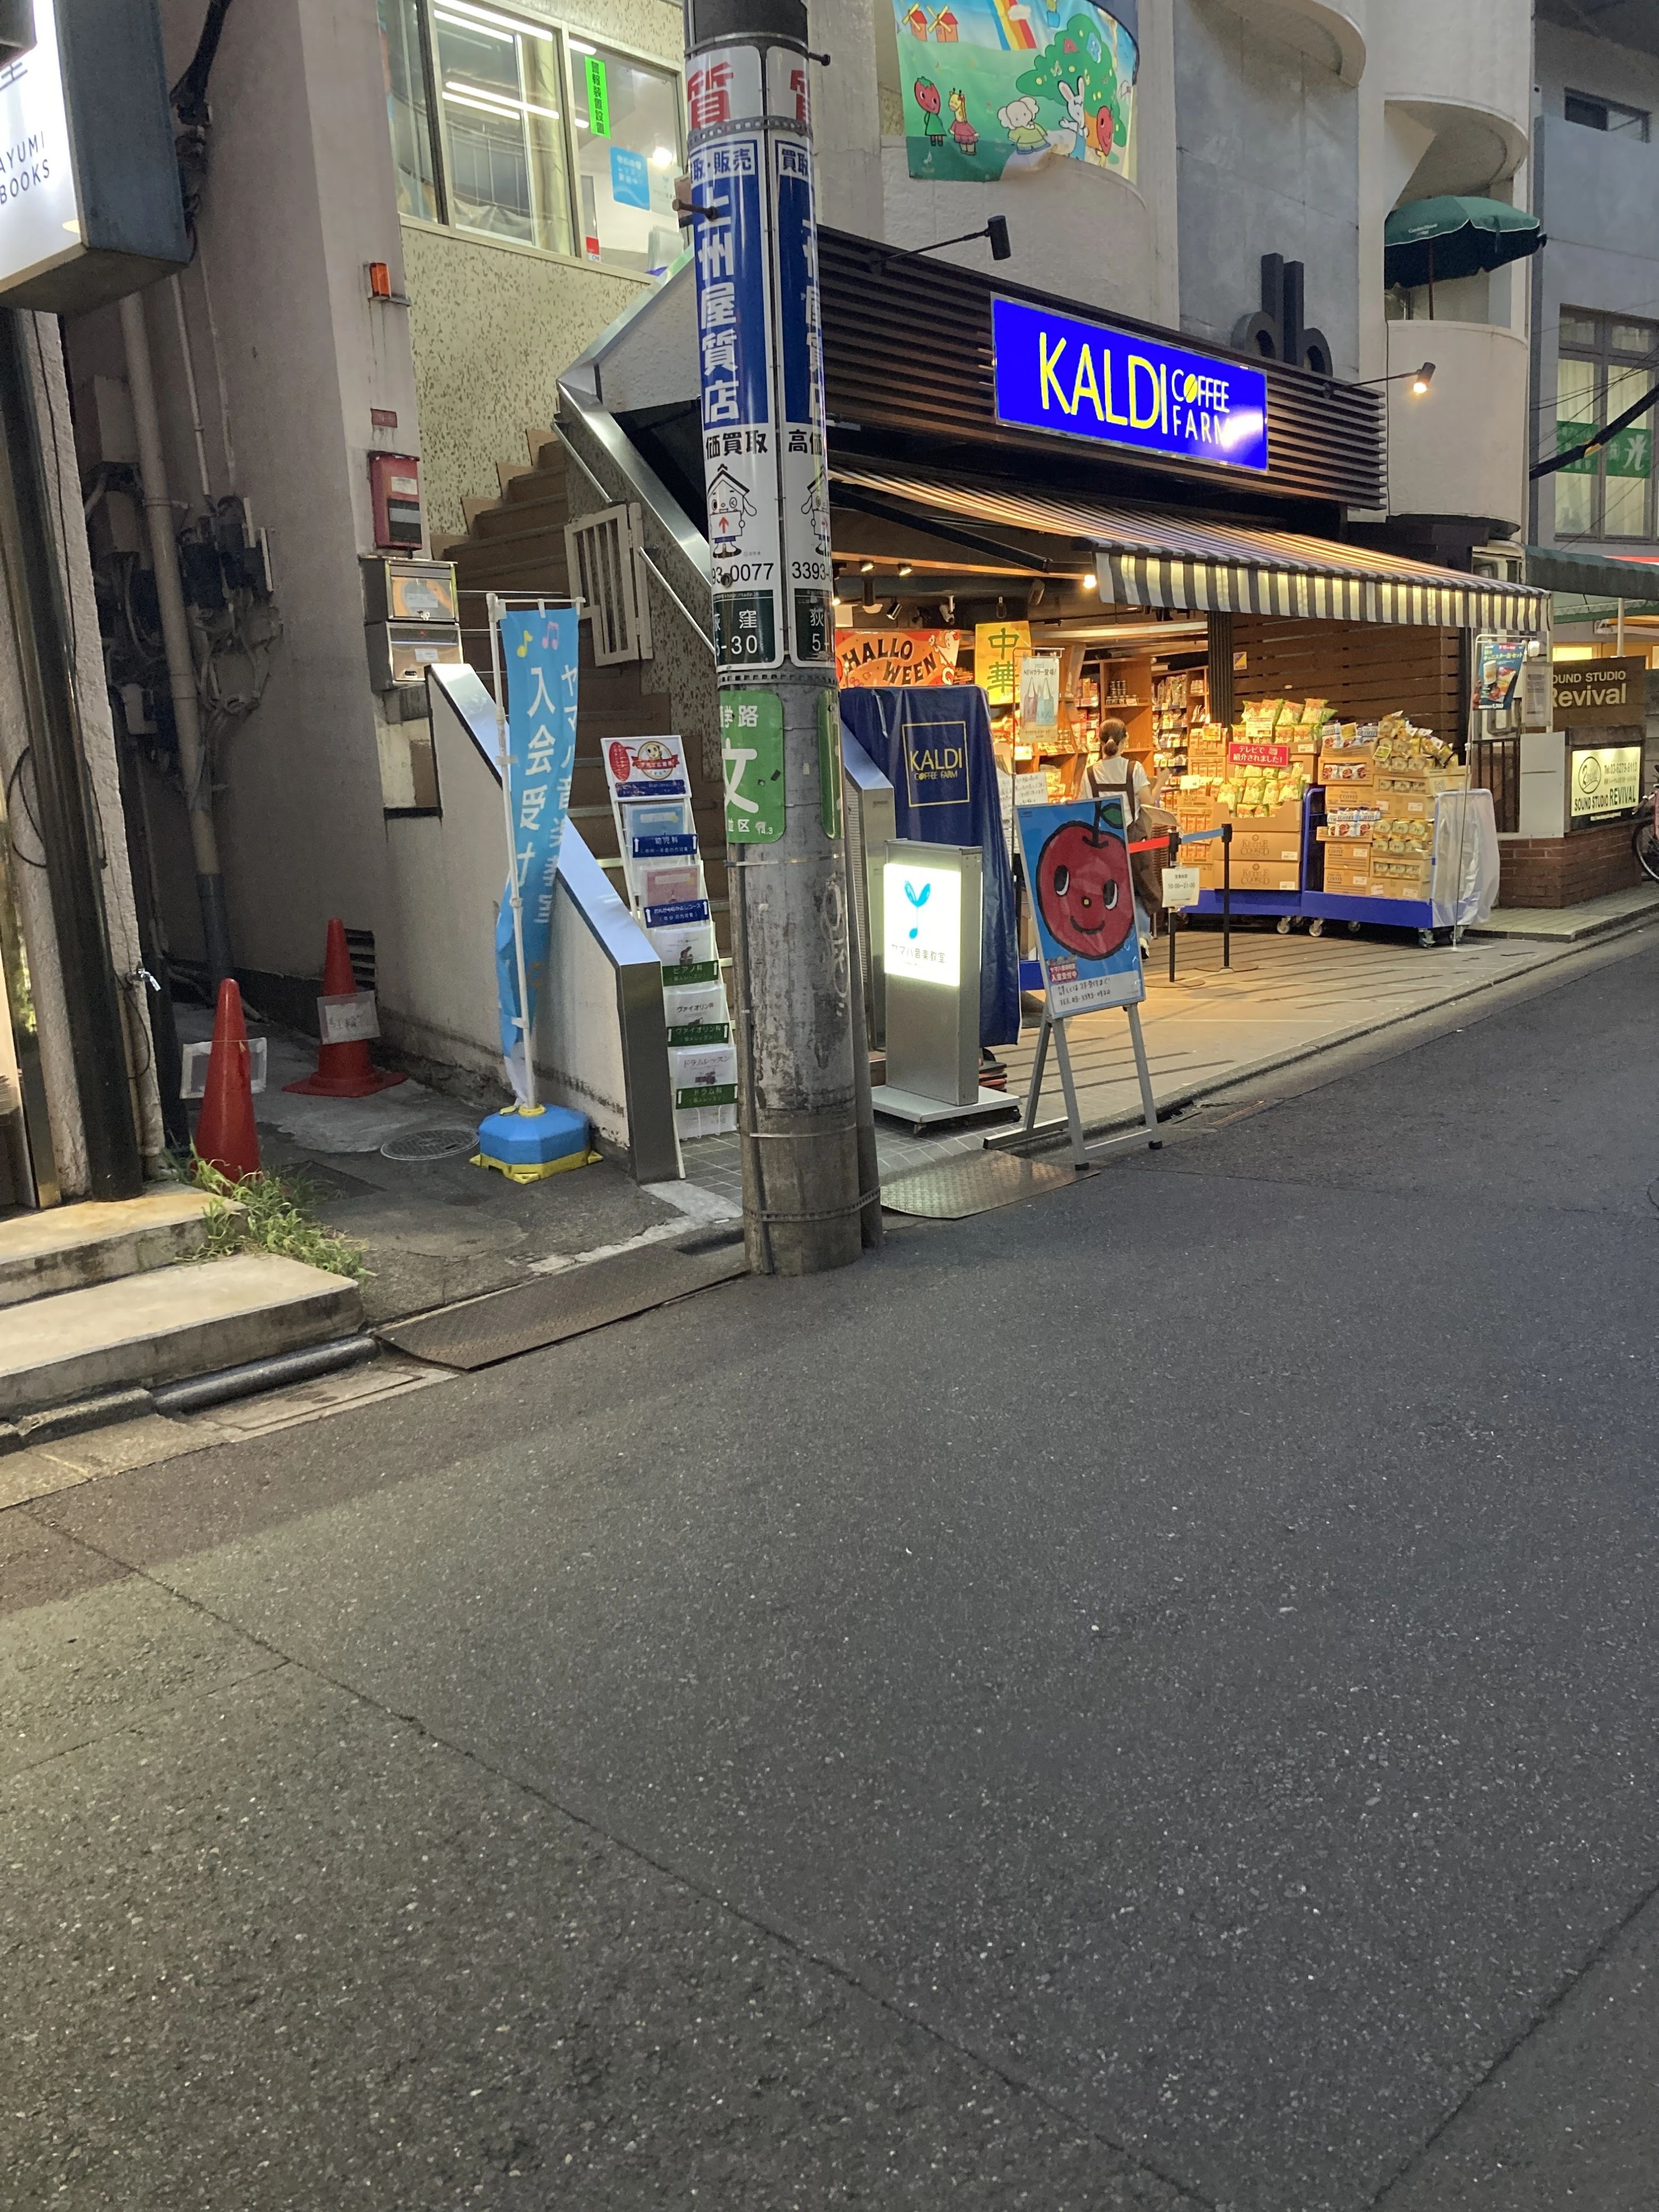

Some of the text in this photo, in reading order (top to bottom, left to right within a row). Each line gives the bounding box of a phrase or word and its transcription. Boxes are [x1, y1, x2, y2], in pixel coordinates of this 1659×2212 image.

[0, 159, 50, 205] BOOKS
[698, 186, 740, 424] 上州屋質店
[1040, 332, 1168, 434] KALDI
[1171, 369, 1230, 413] COFFEE
[842, 638, 913, 673] HALLO
[987, 627, 1020, 693] 中華
[883, 652, 938, 685] WEEN
[1585, 670, 1626, 682] STUDIO
[1553, 683, 1627, 707] Revival
[910, 747, 962, 772] KALDI
[1233, 753, 1283, 763] 紹介されました!
[1239, 746, 1265, 754] テレビで
[914, 770, 958, 780] COFFEE FARM
[1574, 786, 1636, 811] SOUND STUDIO REVIVAL
[1242, 839, 1269, 848] KETTLE
[1243, 868, 1269, 877] KETTLE
[684, 1056, 730, 1068] ドラムレッスン
